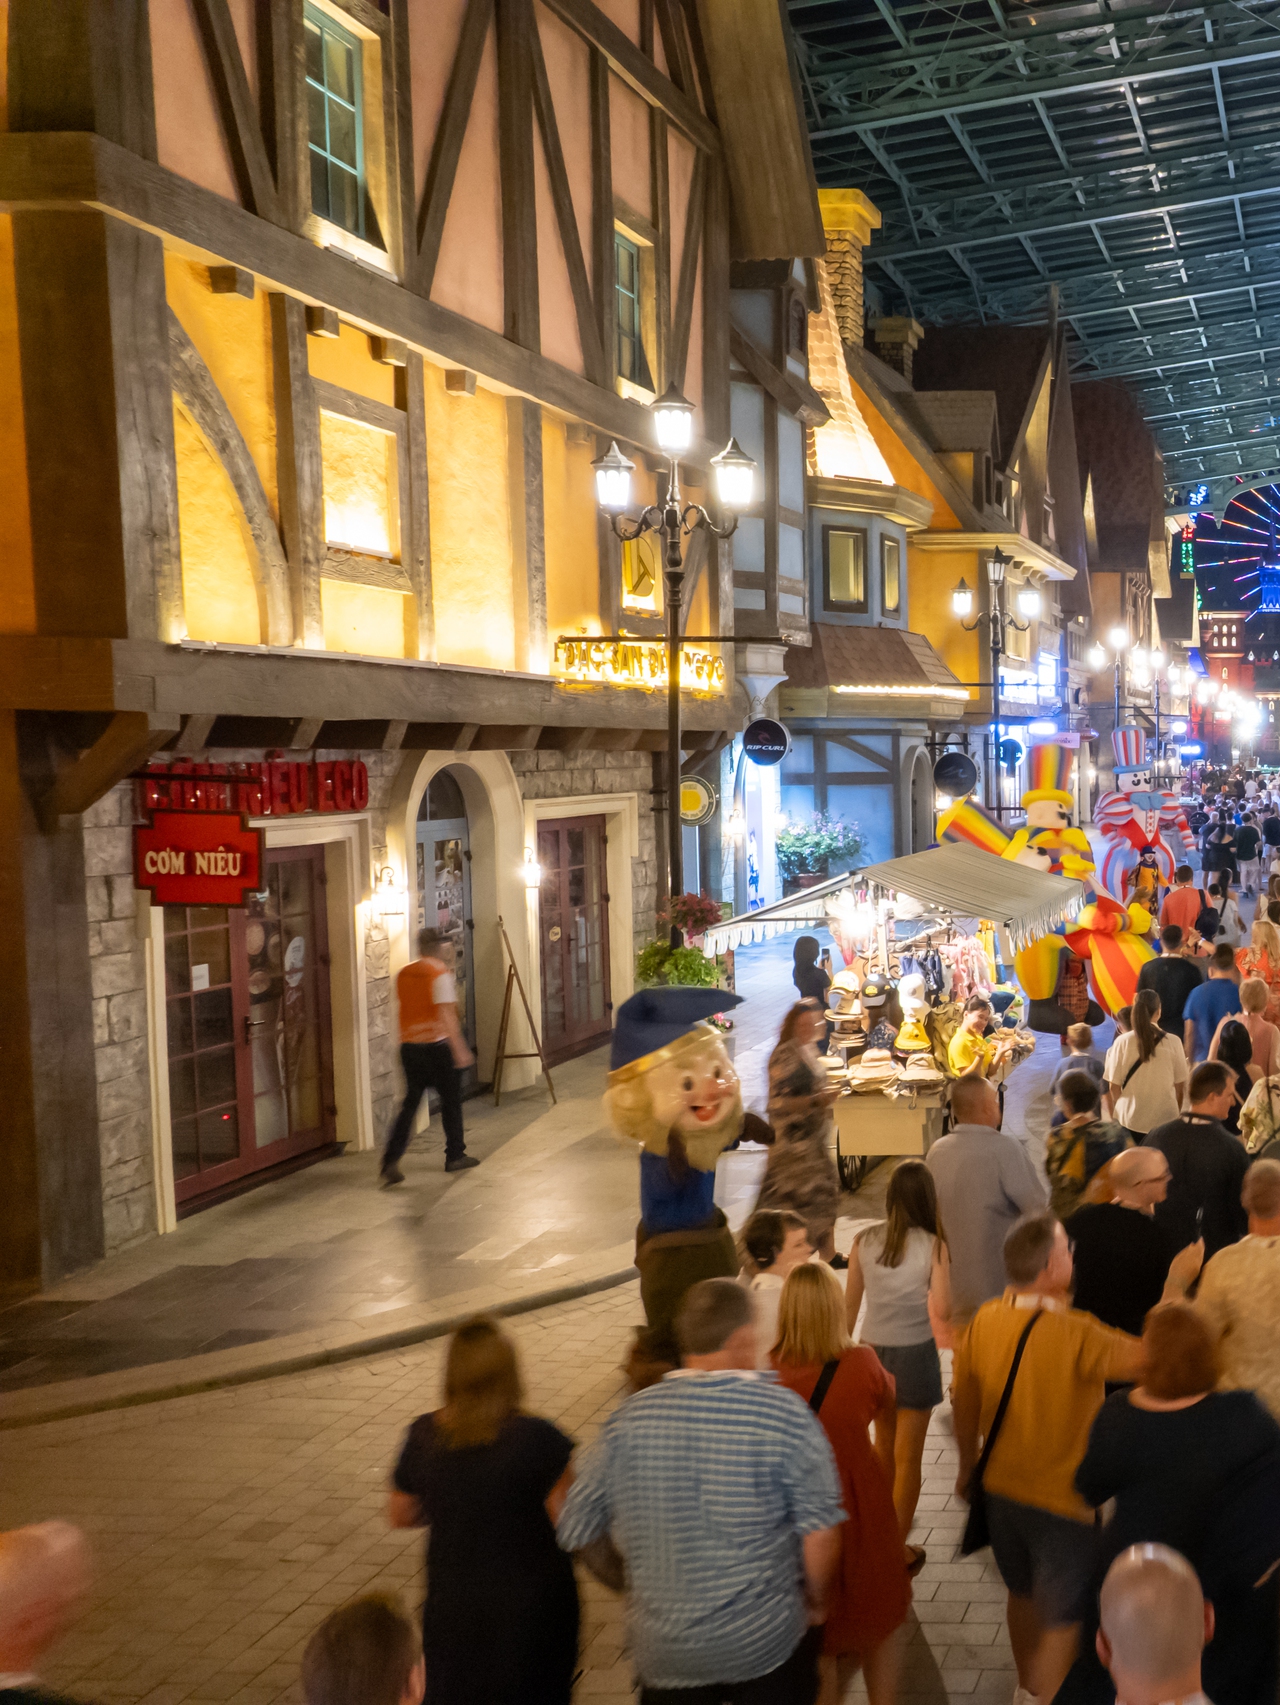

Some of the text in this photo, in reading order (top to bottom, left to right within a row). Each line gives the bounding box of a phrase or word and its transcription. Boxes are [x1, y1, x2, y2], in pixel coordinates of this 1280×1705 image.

[317, 760, 369, 812] ECO
[145, 846, 242, 877] CƠM NIÊU
